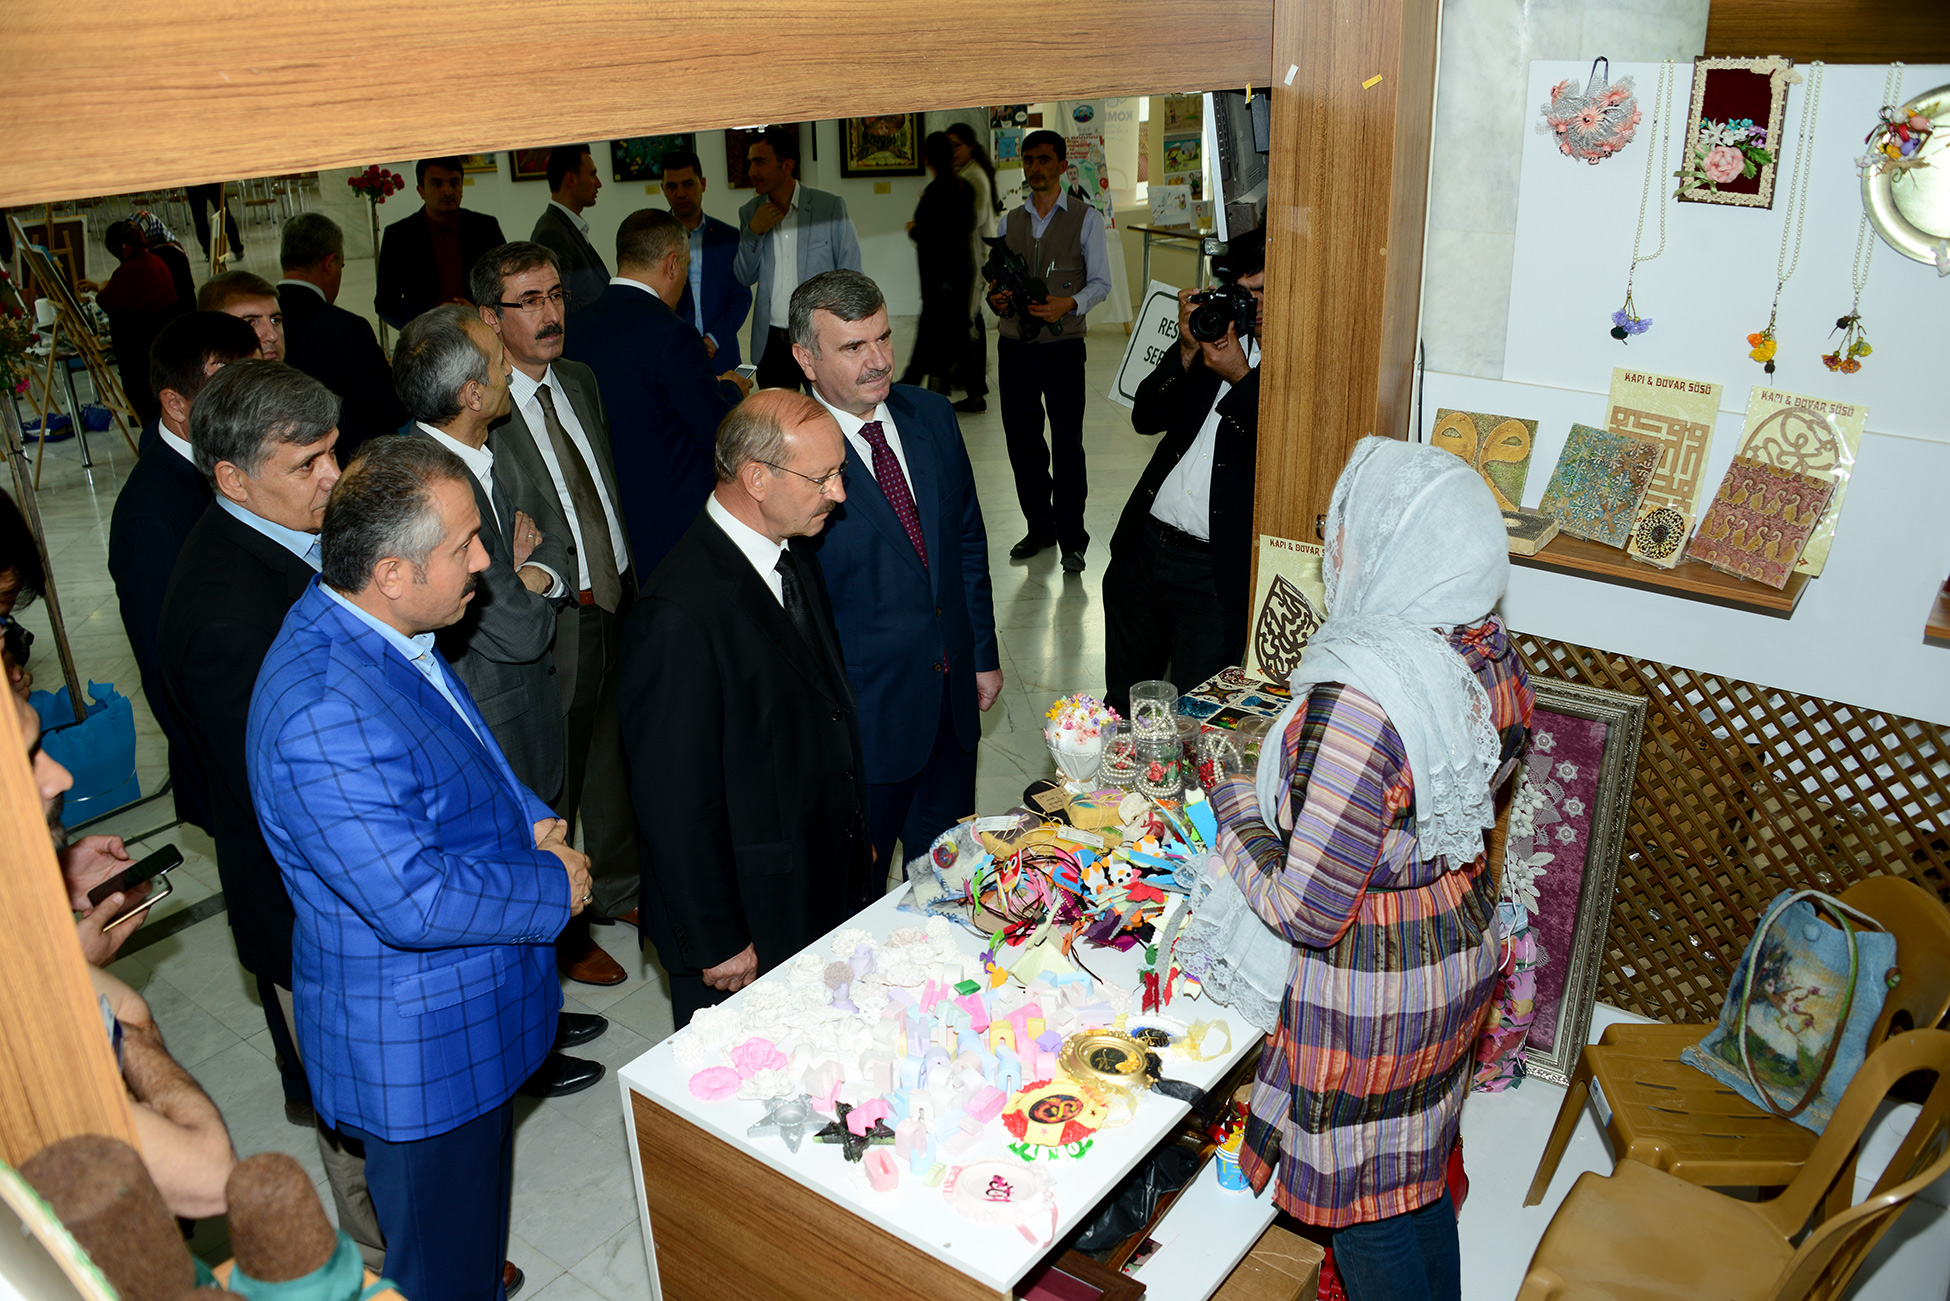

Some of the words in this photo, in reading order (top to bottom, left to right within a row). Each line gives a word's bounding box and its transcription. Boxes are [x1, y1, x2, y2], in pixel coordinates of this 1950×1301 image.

[1157, 317, 1180, 340] RES
[1624, 372, 1645, 385] KAPI
[1646, 376, 1653, 387] &
[1655, 377, 1686, 392] DUVAR
[1688, 381, 1712, 395] SÜSÜ
[1760, 390, 1784, 404] KAPI
[1784, 395, 1792, 406] &
[1794, 397, 1827, 413] DUVAR
[1829, 402, 1855, 417] SÜSÜ
[1270, 539, 1286, 549] KAPI
[1288, 542, 1294, 551] &
[1295, 543, 1320, 557] DUVAR
